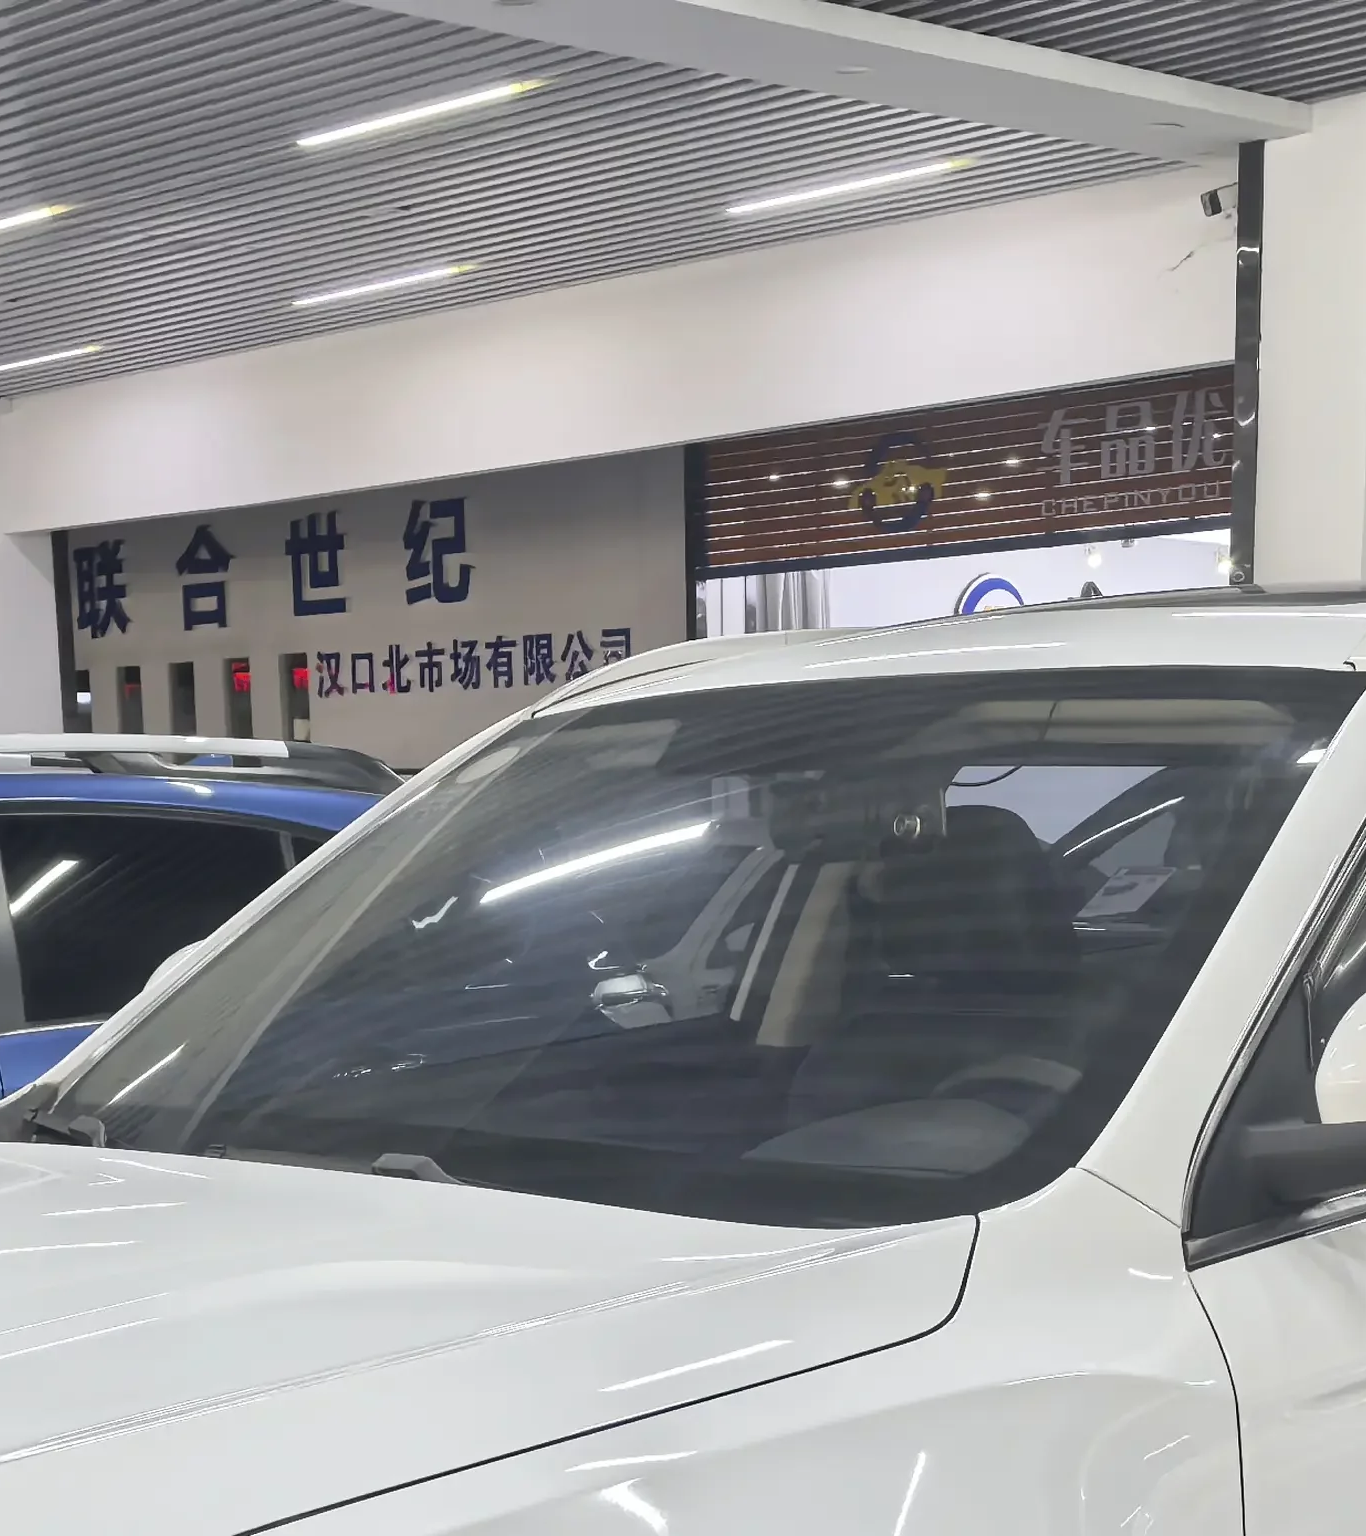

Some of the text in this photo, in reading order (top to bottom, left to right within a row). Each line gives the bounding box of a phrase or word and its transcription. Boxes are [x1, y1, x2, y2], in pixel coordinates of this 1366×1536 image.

[71, 496, 477, 639] 联合世纪
[316, 626, 633, 699] 汉口北市场有限公司
